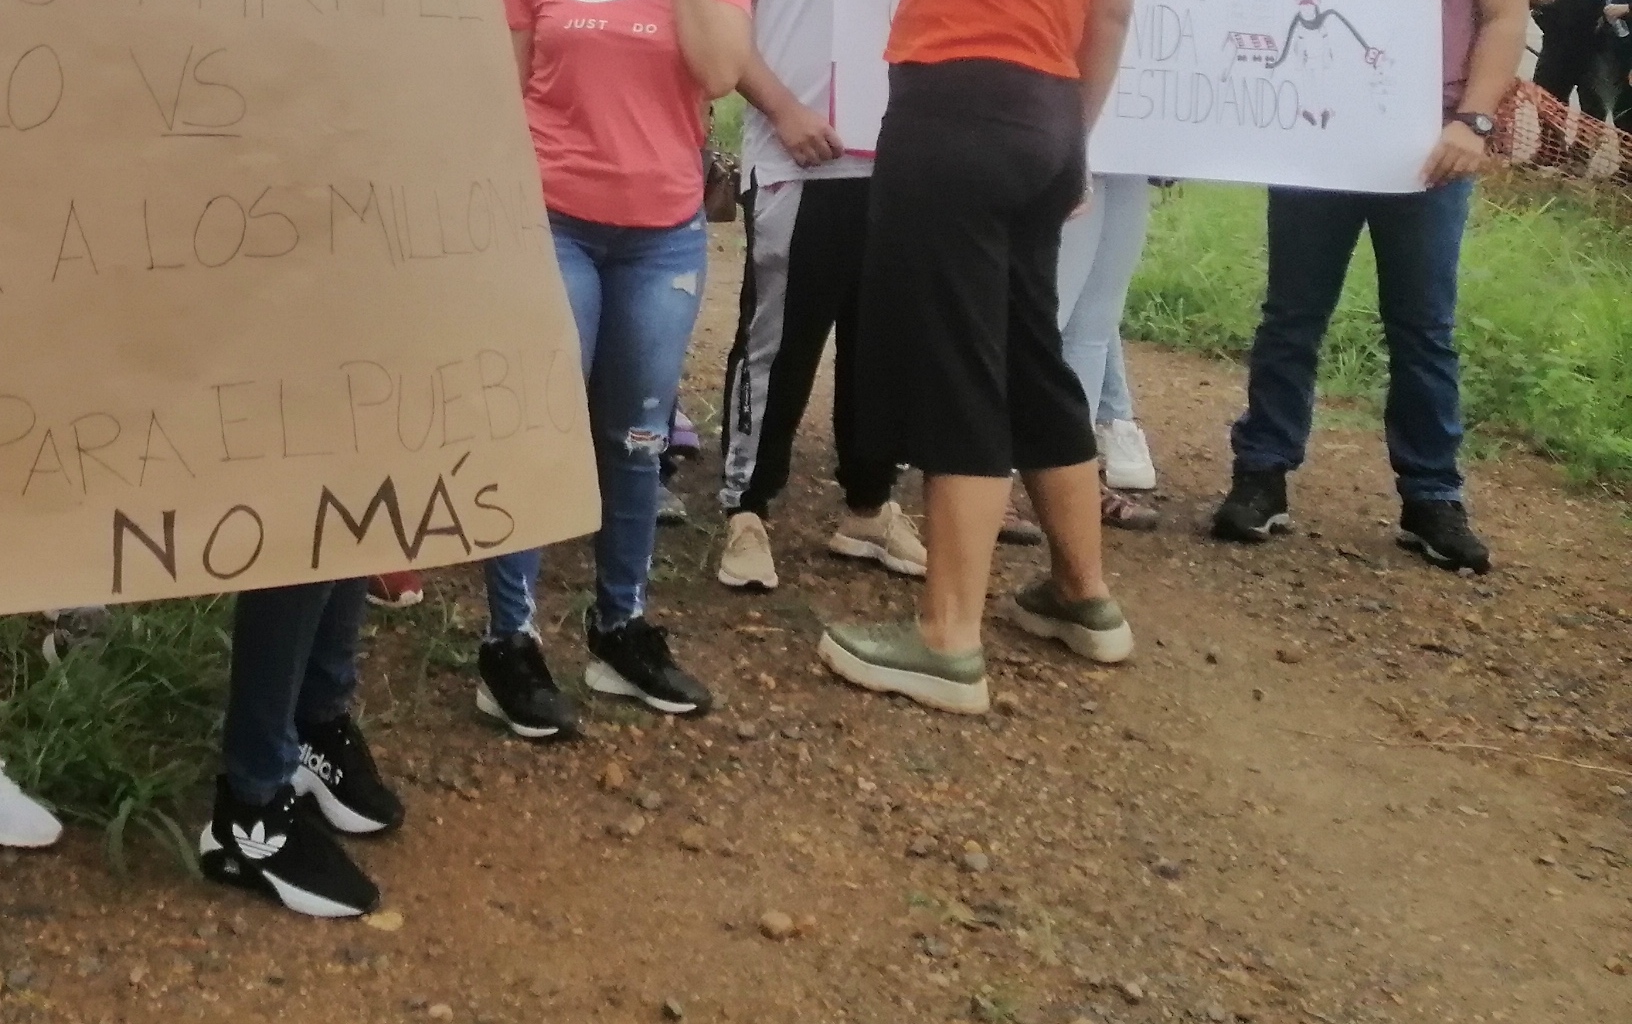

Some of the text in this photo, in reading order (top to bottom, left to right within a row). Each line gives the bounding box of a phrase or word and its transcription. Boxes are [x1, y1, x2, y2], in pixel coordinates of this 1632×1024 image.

[564, 18, 658, 34] JUST DO
[128, 43, 248, 135] VS
[51, 197, 100, 283] A
[141, 183, 301, 271] LOS
[209, 378, 336, 463] EL
[338, 347, 580, 454] PUEBLO
[110, 450, 516, 596] NO MÁS
